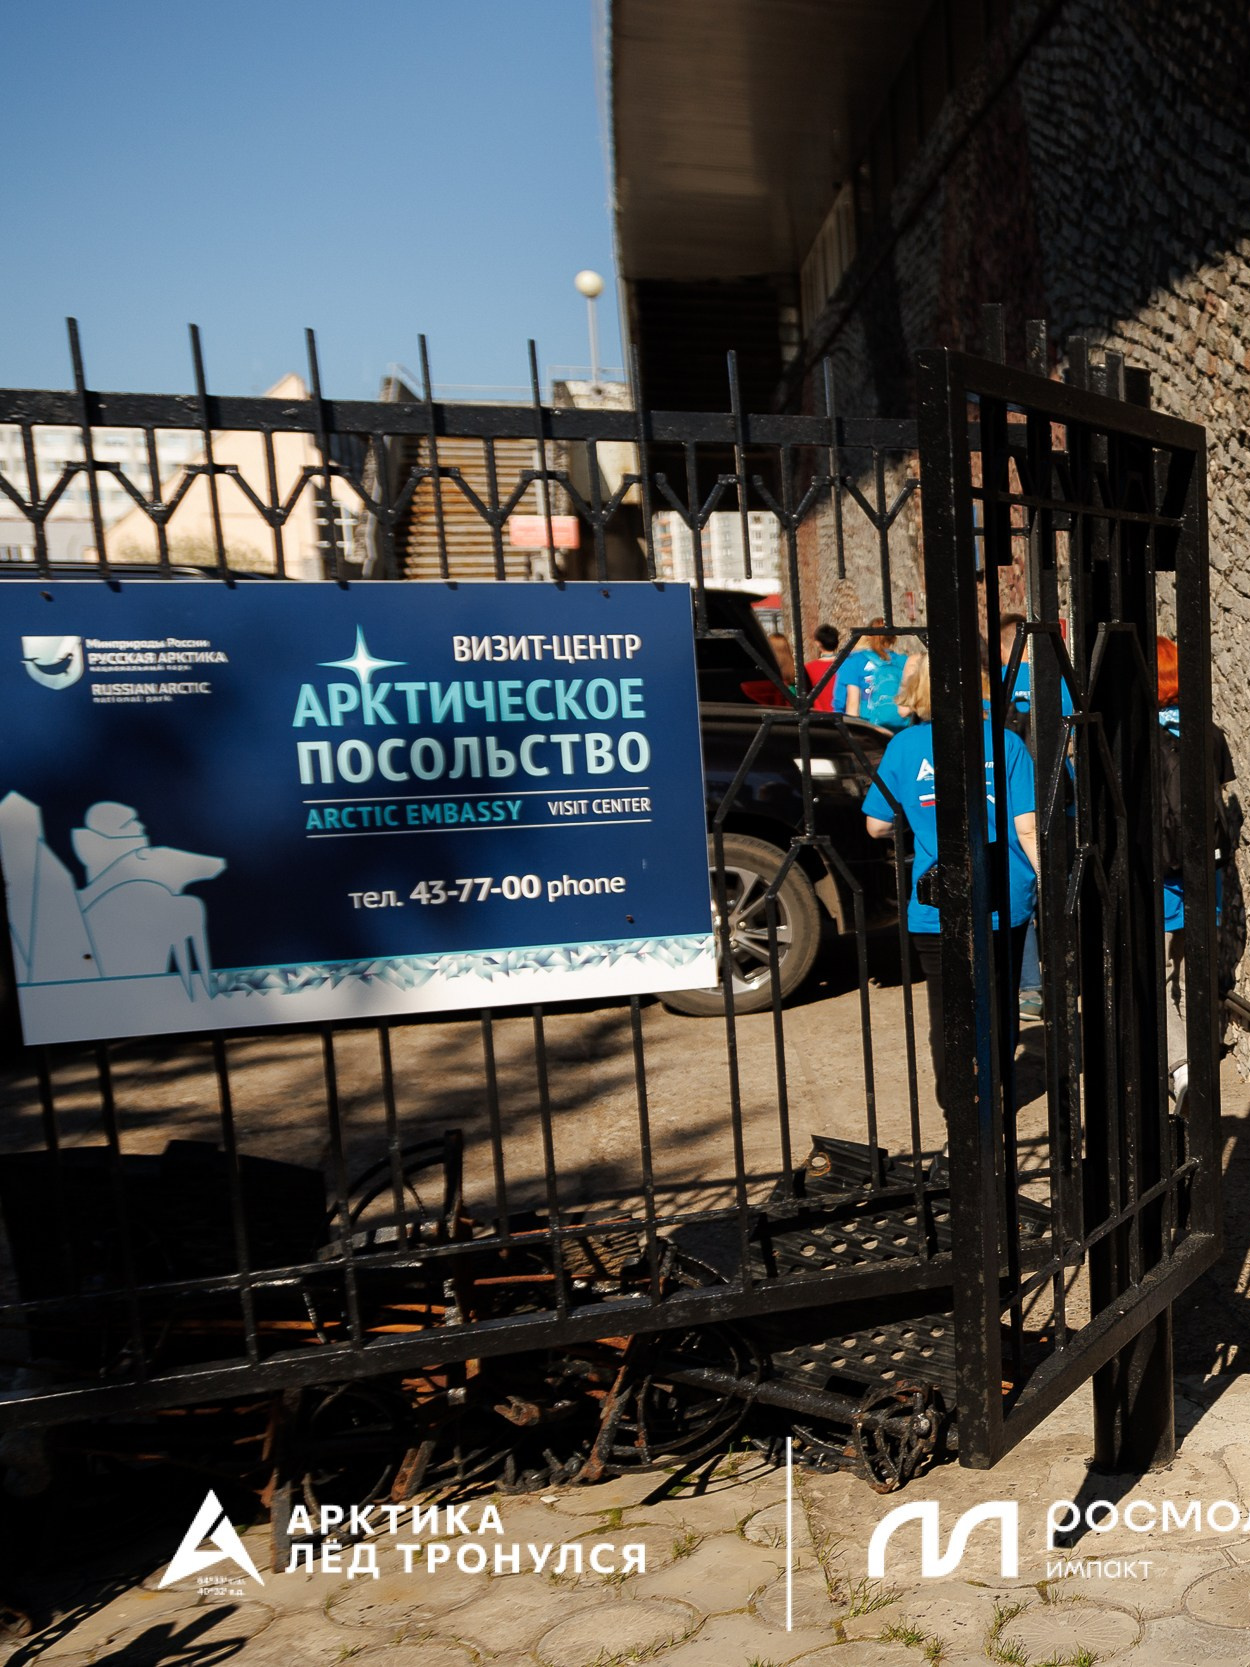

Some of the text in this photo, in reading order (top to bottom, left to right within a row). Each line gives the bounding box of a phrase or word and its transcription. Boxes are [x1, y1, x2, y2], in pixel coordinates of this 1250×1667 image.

[86, 638, 210, 649] Минприроды России
[88, 652, 228, 664] РУССКАЯ АРКТИКА
[453, 634, 642, 663] ВИЗИТ-ЦЕНТР
[91, 682, 212, 696] RUSSIAN ARCTIC
[292, 677, 646, 727] АРКТИЧЕСКОЕ
[296, 731, 650, 785] ПОСОЛЬСТВО
[305, 800, 523, 830] ARCTIC EMBASSY
[548, 797, 651, 816] VISIT CENTER
[348, 874, 626, 909] тел. 43-77-00 phone
